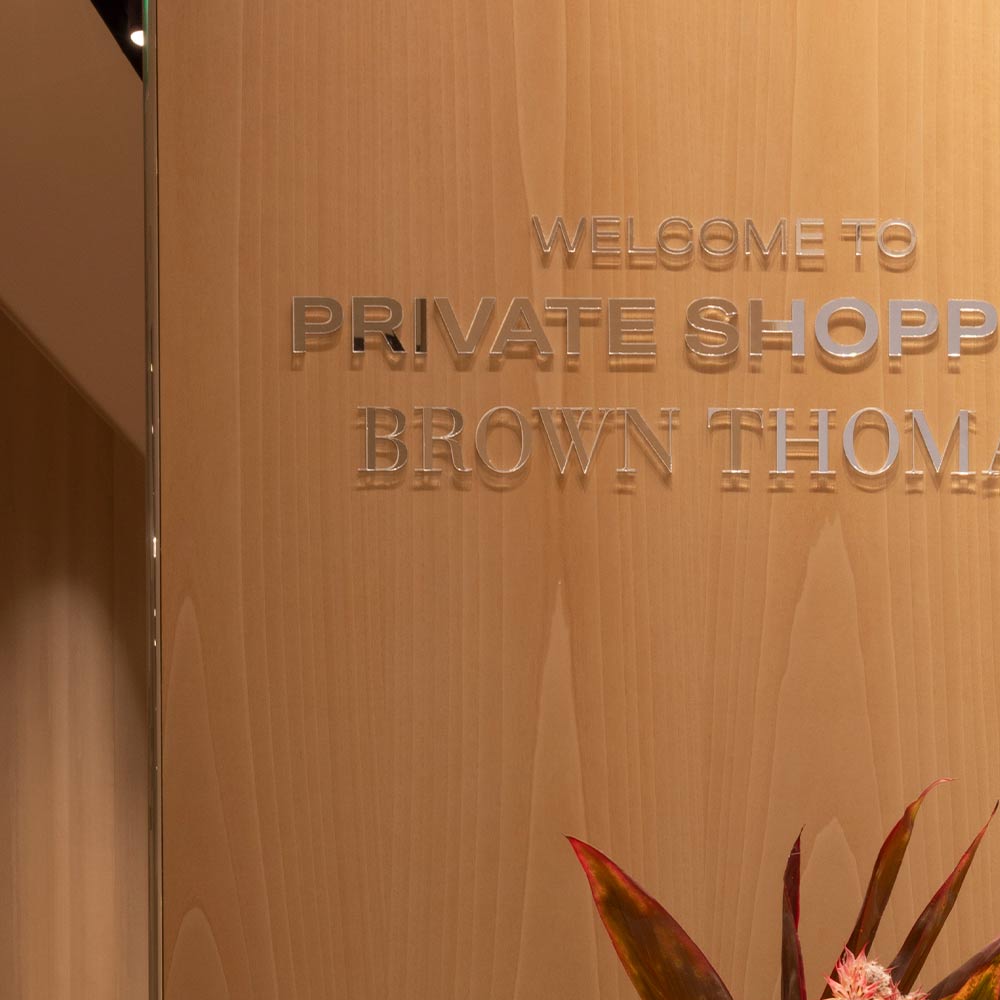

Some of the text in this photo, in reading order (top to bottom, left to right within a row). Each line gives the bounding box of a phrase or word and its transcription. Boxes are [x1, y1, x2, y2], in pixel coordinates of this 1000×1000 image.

[531, 215, 917, 258] WELCOME TO
[291, 296, 657, 356] PRIVATE
[357, 405, 680, 475] BROWN
